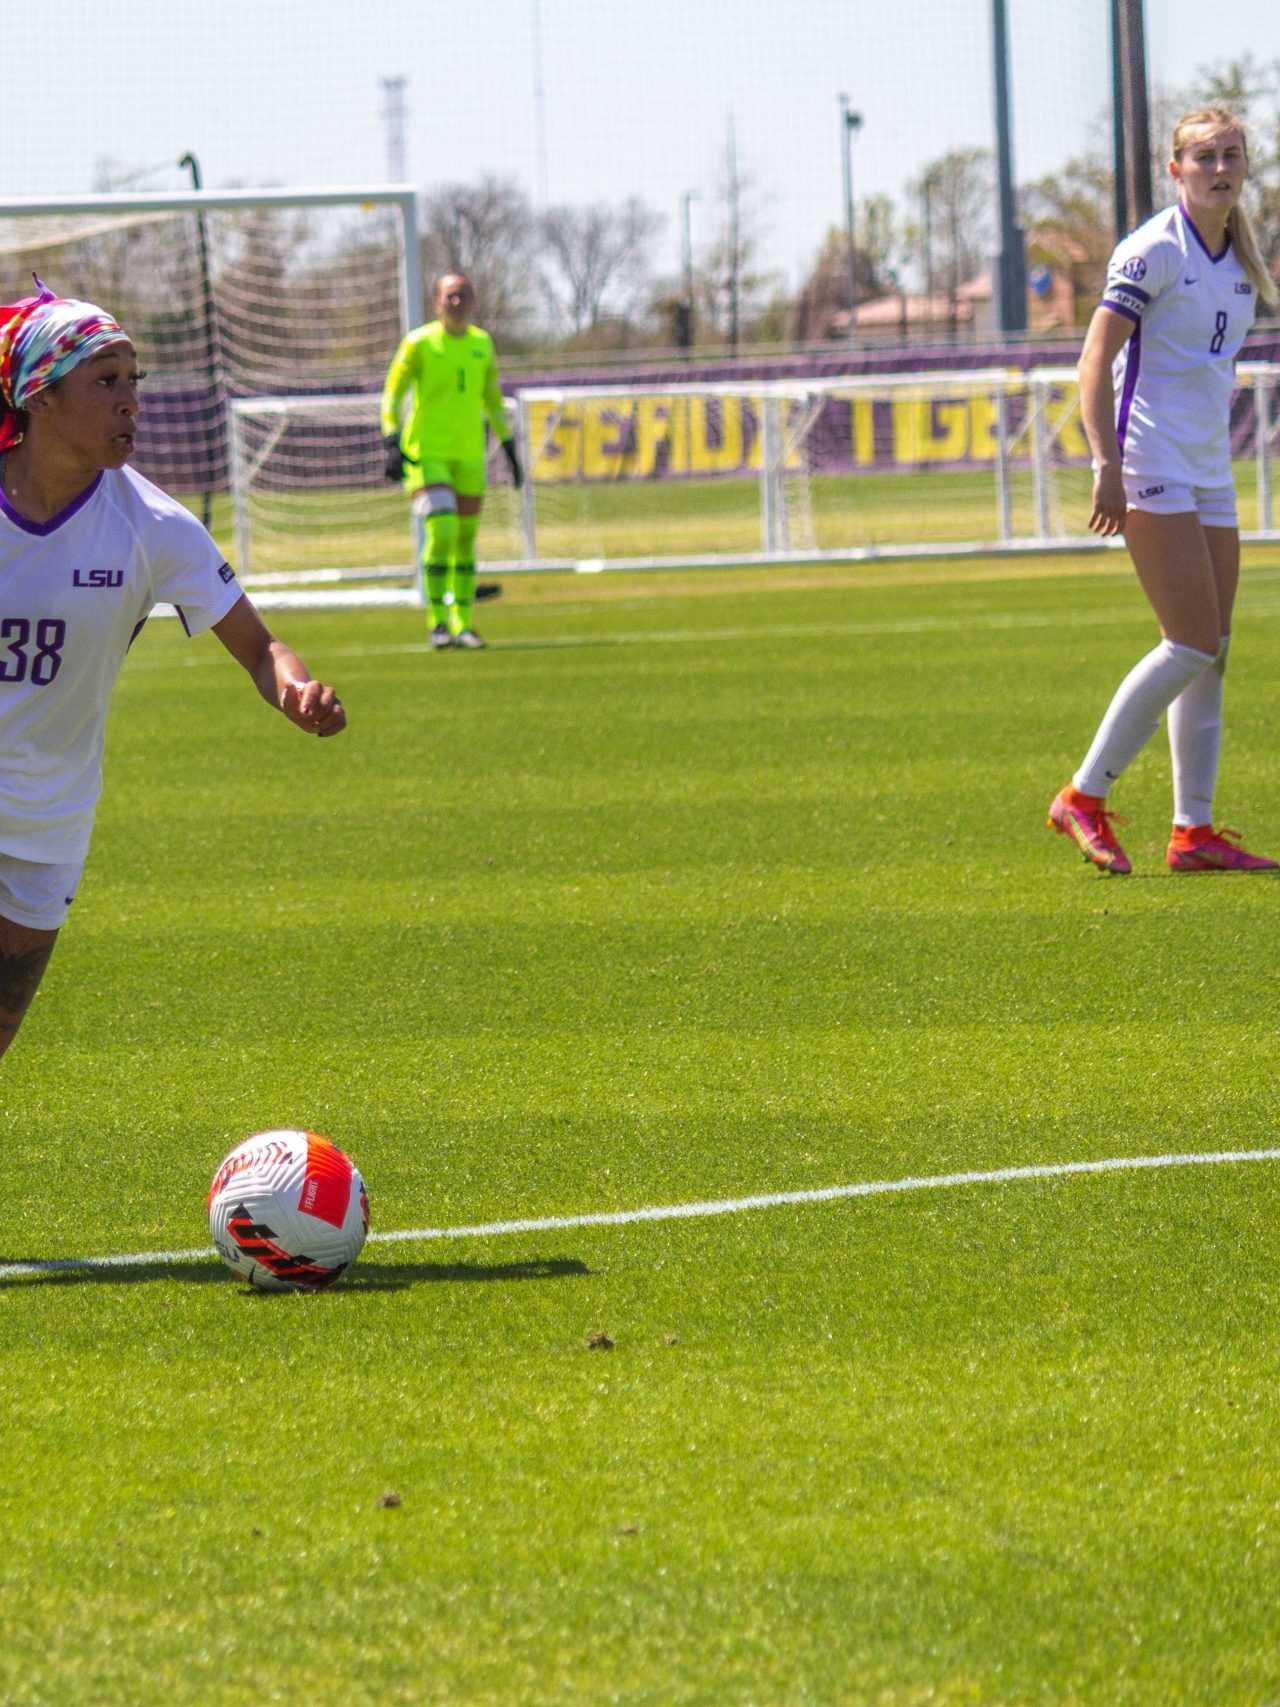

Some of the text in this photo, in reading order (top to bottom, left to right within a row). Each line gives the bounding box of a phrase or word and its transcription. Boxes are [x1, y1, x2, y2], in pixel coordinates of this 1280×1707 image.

[1210, 311, 1227, 354] 8
[457, 367, 466, 394] 1
[527, 392, 805, 478] GEAUX
[1138, 485, 1164, 499] LSU
[73, 569, 124, 588] LSU
